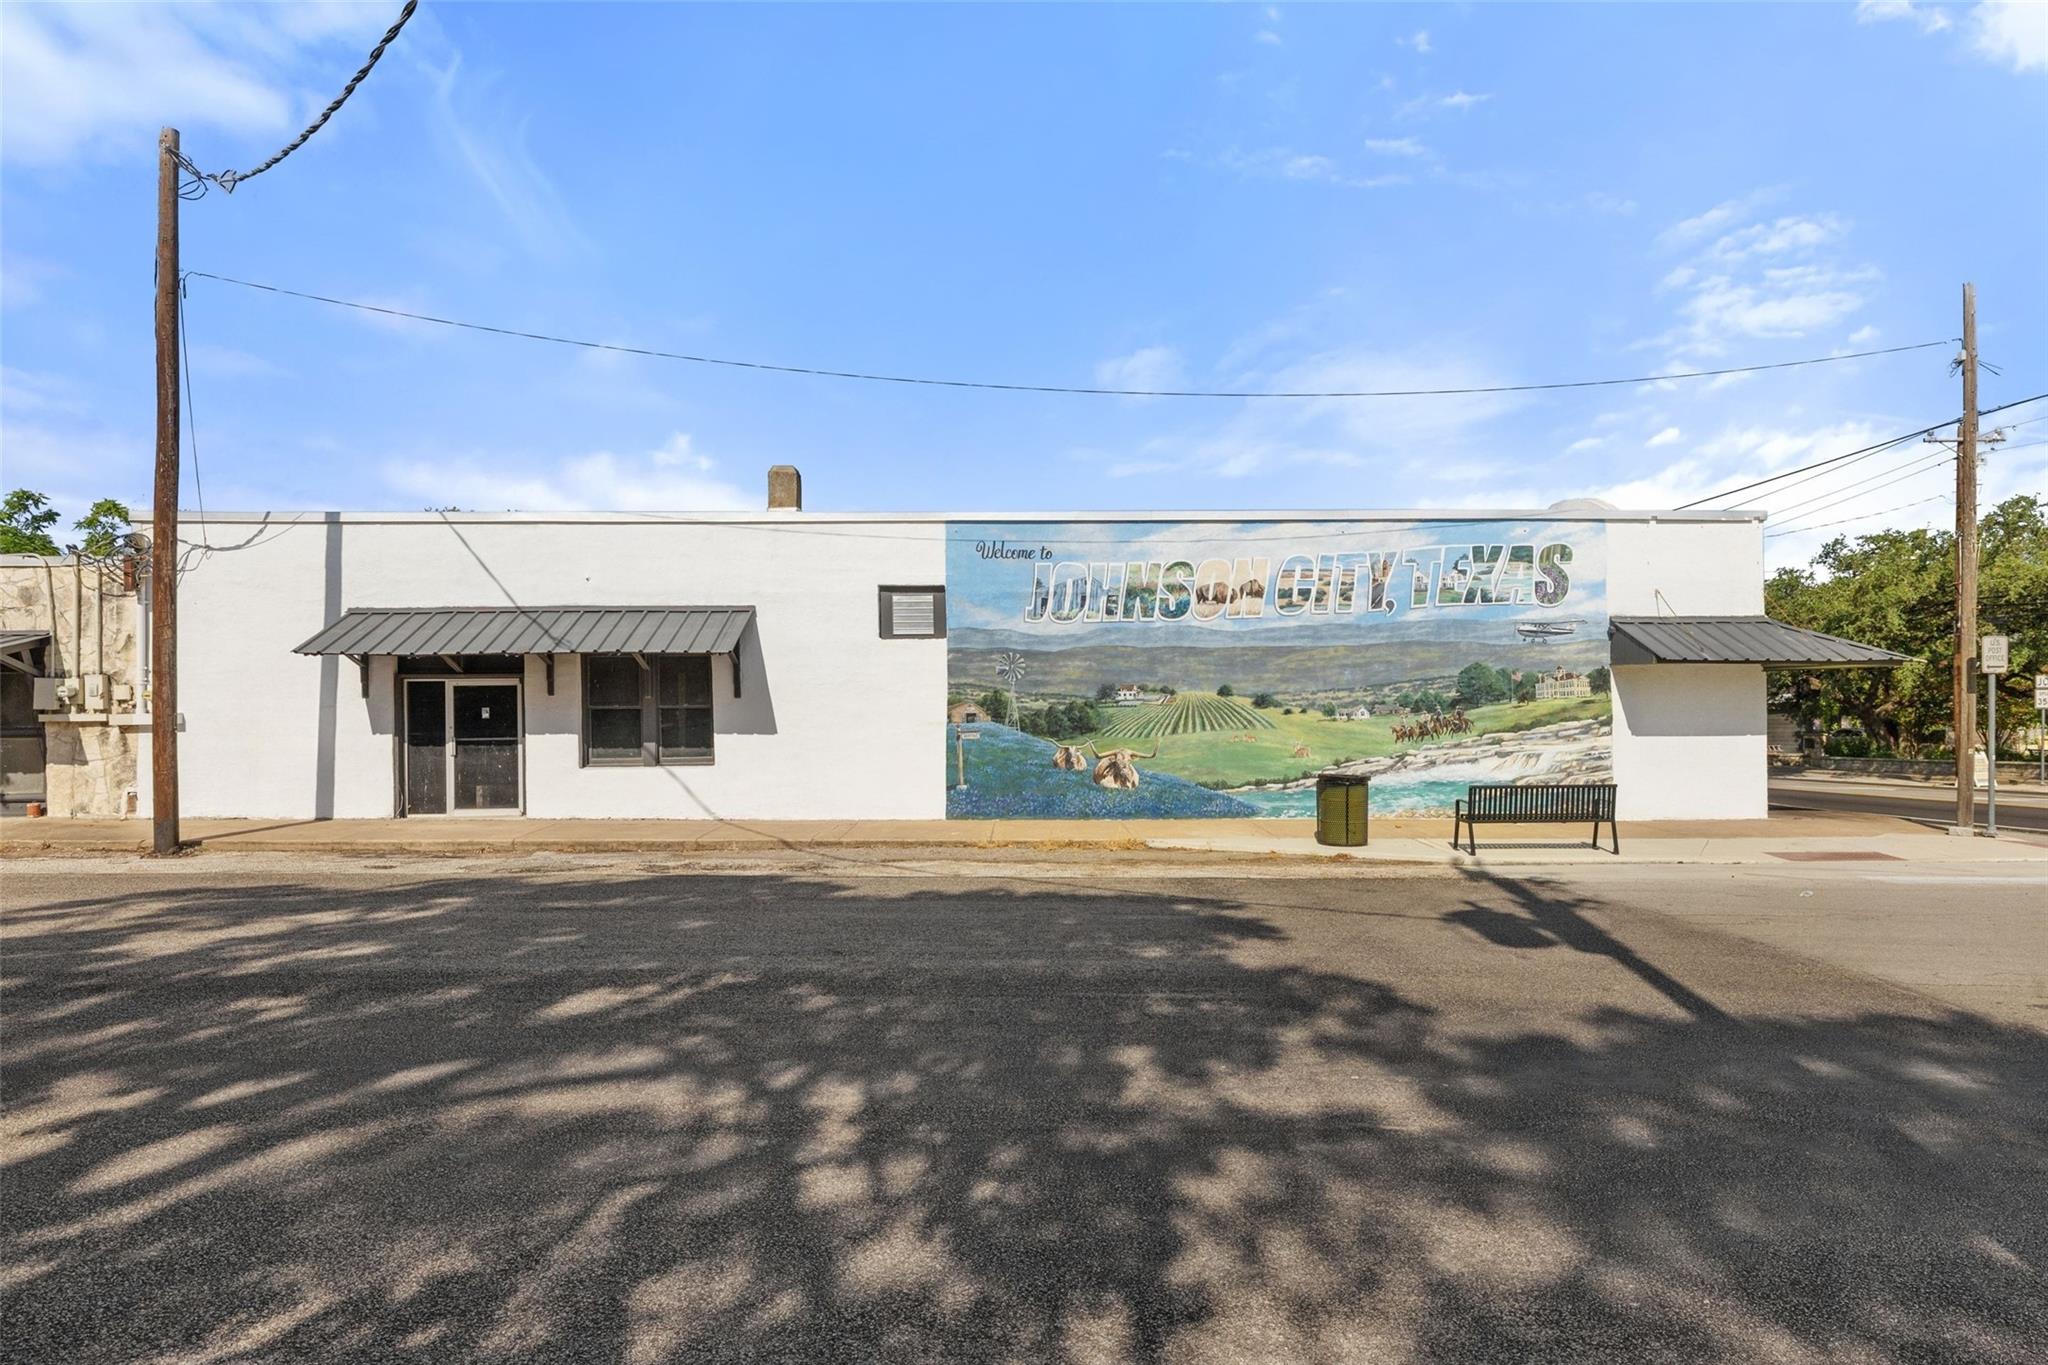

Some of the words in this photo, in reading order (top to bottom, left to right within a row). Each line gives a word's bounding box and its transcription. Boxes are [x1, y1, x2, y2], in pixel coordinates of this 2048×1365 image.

[976, 540, 1036, 560] Welcome
[1040, 545, 1053, 560] to
[1024, 556, 1271, 624] JOHNSON
[1275, 550, 1399, 616] CITY,
[1402, 542, 1574, 608] TEXAS
[1985, 654, 2005, 662] OFFICE
